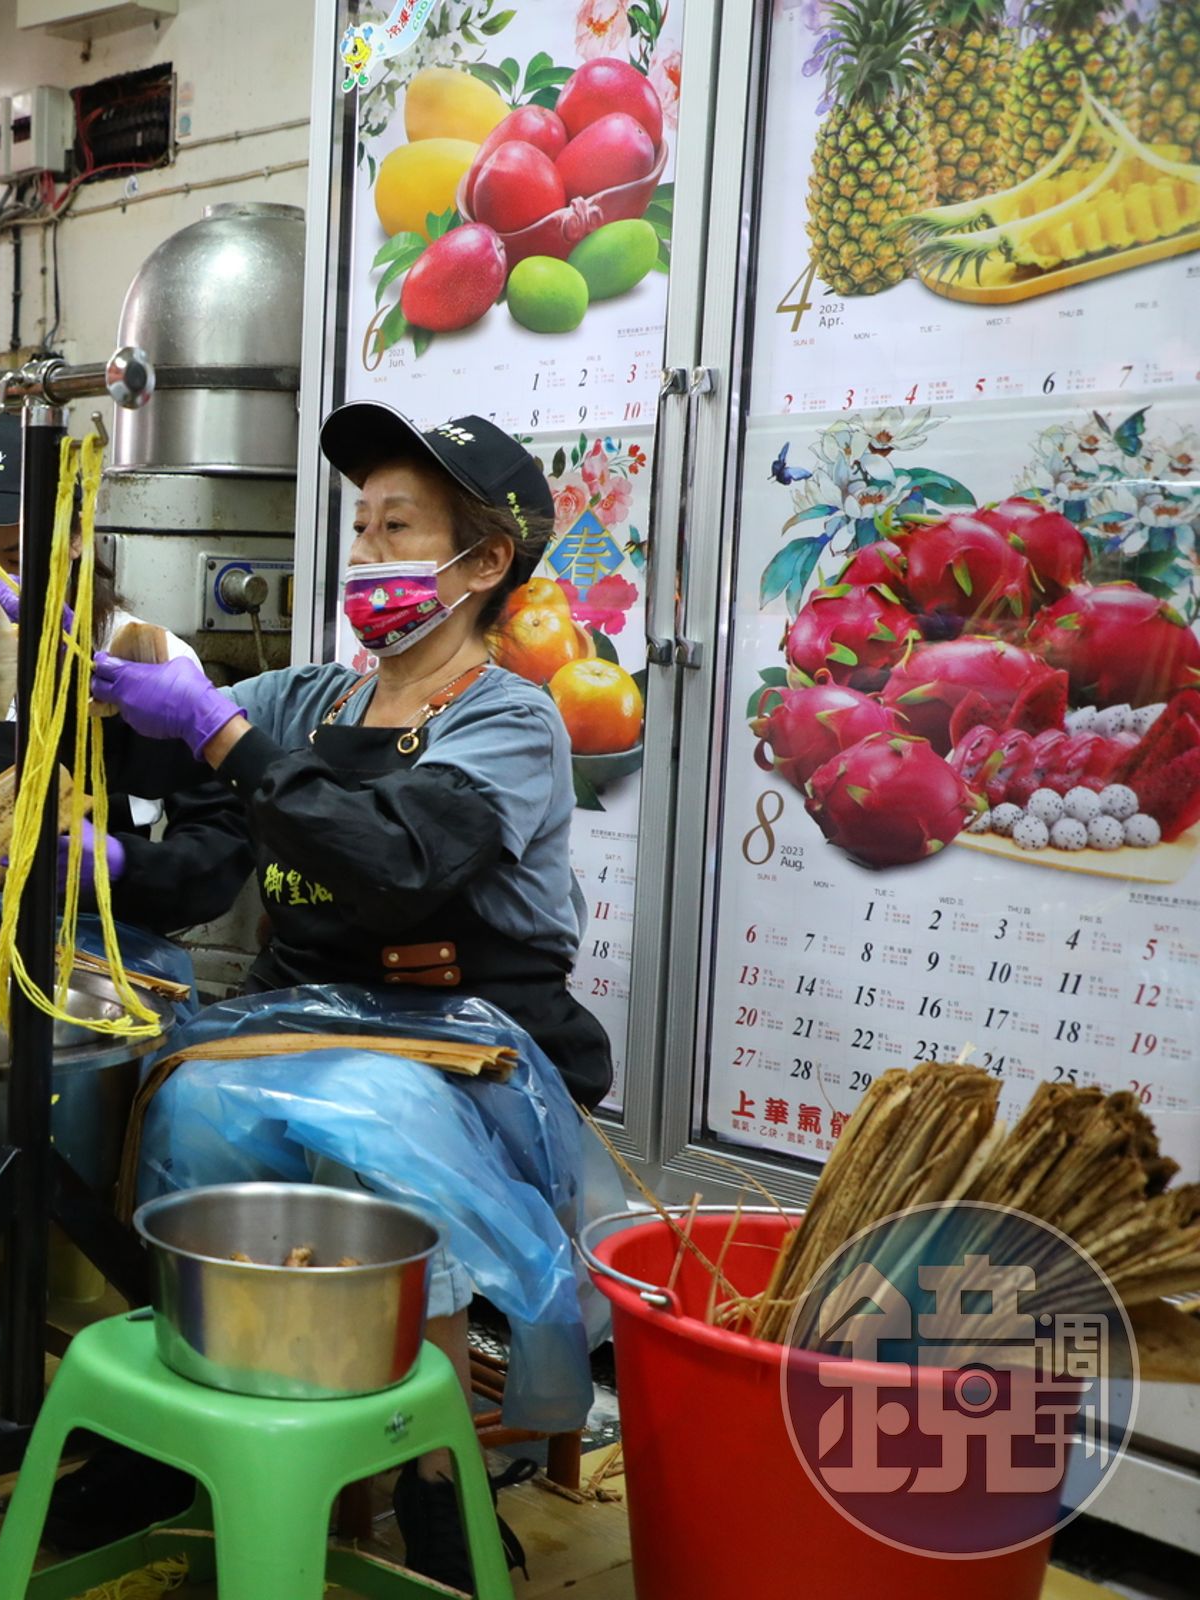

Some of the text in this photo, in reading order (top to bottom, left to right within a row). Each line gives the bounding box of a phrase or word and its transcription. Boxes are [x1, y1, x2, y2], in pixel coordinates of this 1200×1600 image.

[776, 257, 819, 332] 4
[819, 303, 845, 314] 2023
[819, 316, 844, 328] Apr.
[920, 325, 932, 333] TUE
[362, 304, 390, 372] 6
[854, 332, 870, 340] MON
[388, 358, 405, 368] Jun.
[533, 364, 637, 390] 1 2 3
[782, 394, 793, 413] 2
[843, 389, 854, 410] 3
[905, 384, 918, 404] 4
[1043, 373, 1054, 393] 6
[1120, 365, 1133, 387] 7
[531, 410, 539, 426] 8
[579, 406, 587, 423] 9
[624, 403, 640, 420] 10
[559, 527, 611, 586] 春
[742, 790, 784, 865] 8
[780, 845, 804, 856] 2023
[780, 857, 805, 871] Aug.
[598, 866, 607, 883] 4
[757, 873, 770, 881] SUN
[939, 897, 957, 905] WED
[1008, 905, 1022, 914] THU
[595, 902, 609, 919] 11
[1080, 915, 1093, 923] FRI
[865, 902, 874, 921] 1
[929, 910, 942, 930] 2
[995, 919, 1007, 939] 3
[1066, 929, 1080, 950] 4
[1143, 939, 1157, 960] 5
[1154, 924, 1170, 932] SAT
[592, 940, 609, 959] 18
[746, 925, 756, 943] 6
[805, 933, 815, 951] 7
[861, 943, 873, 962] 8
[928, 952, 939, 971] 9
[988, 962, 1011, 983] 10
[1059, 973, 1082, 994] 11
[1135, 984, 1160, 1007] 12
[591, 978, 609, 996] 25
[739, 966, 1158, 1055] 13 14 15 16 17 18 19
[736, 1007, 757, 1026] 20
[792, 1017, 813, 1038] 21
[851, 1028, 874, 1050] 22
[913, 1040, 938, 1062] 23
[983, 1052, 1005, 1076] 24
[1052, 1066, 1079, 1085] 25
[1128, 1080, 1153, 1104] 26
[733, 1047, 872, 1092] 27 28 29
